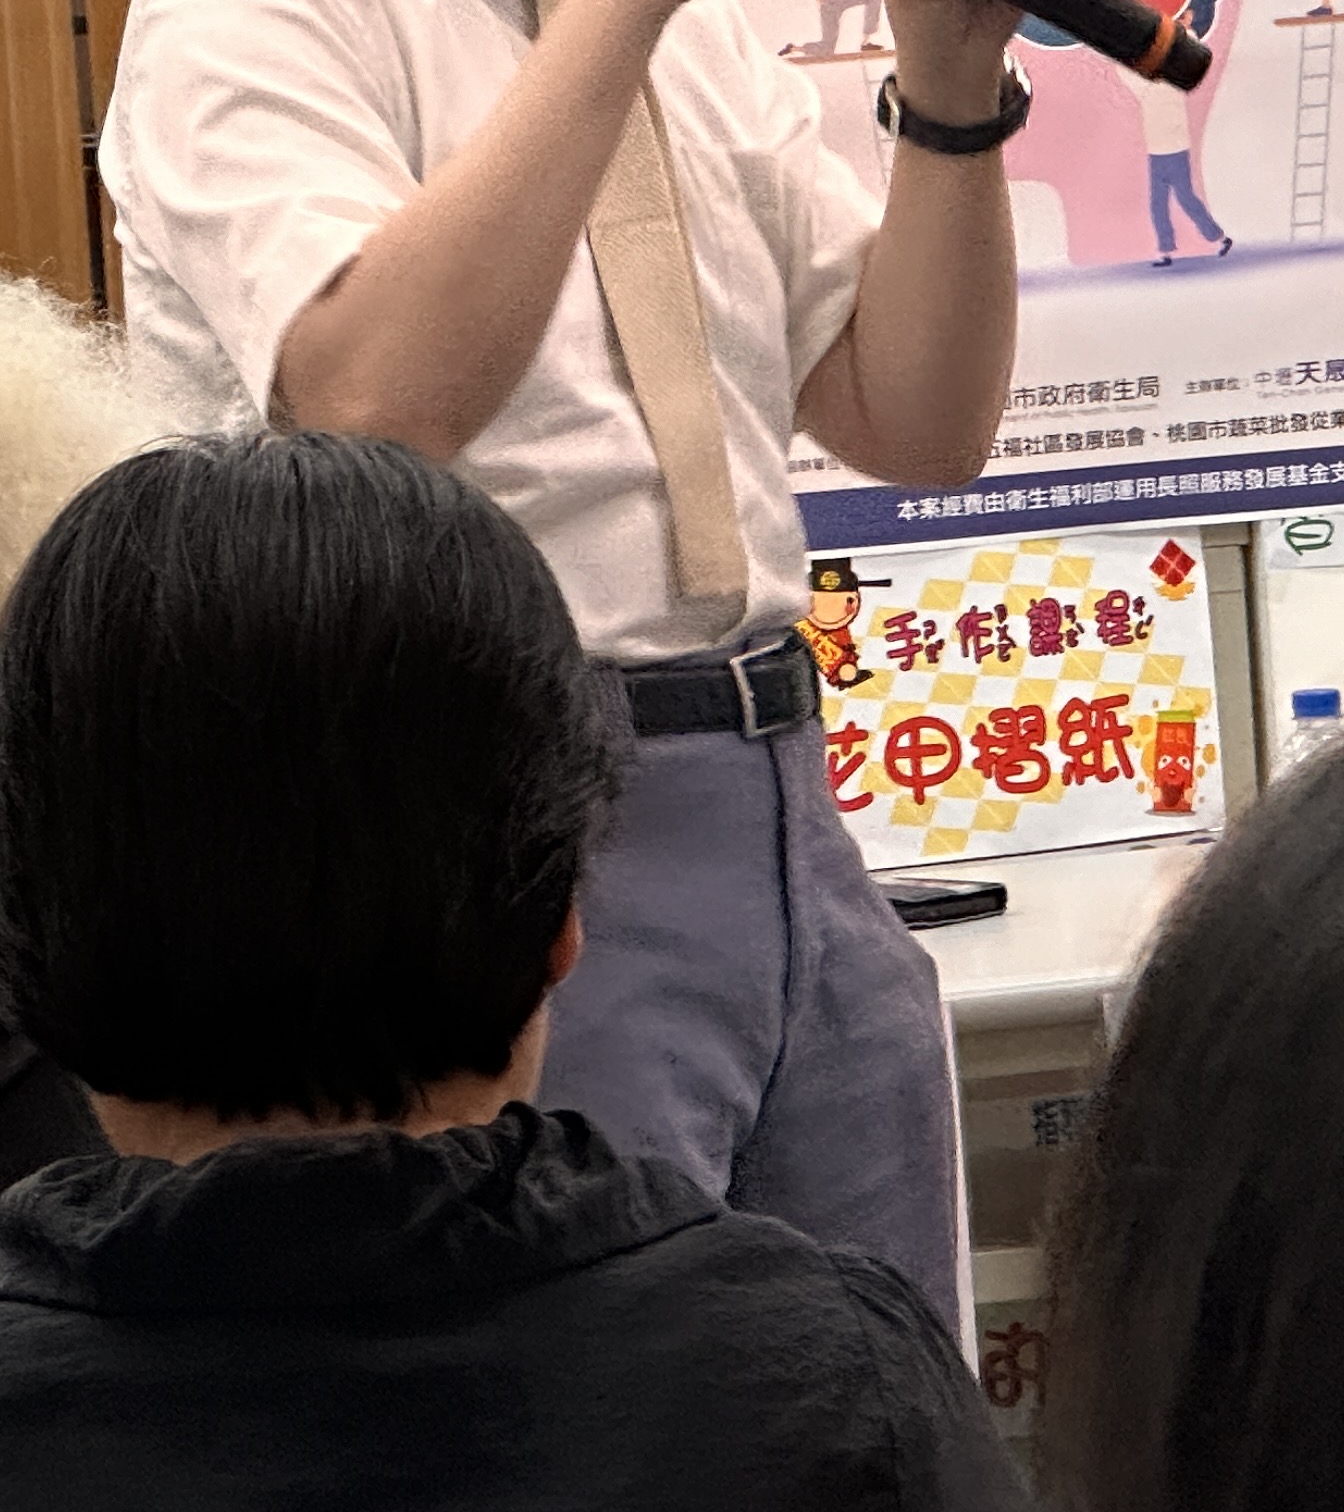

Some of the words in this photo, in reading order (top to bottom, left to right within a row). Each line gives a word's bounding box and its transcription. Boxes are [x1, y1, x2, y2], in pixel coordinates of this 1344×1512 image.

[1003, 374, 1161, 411] 市政府衛生局
